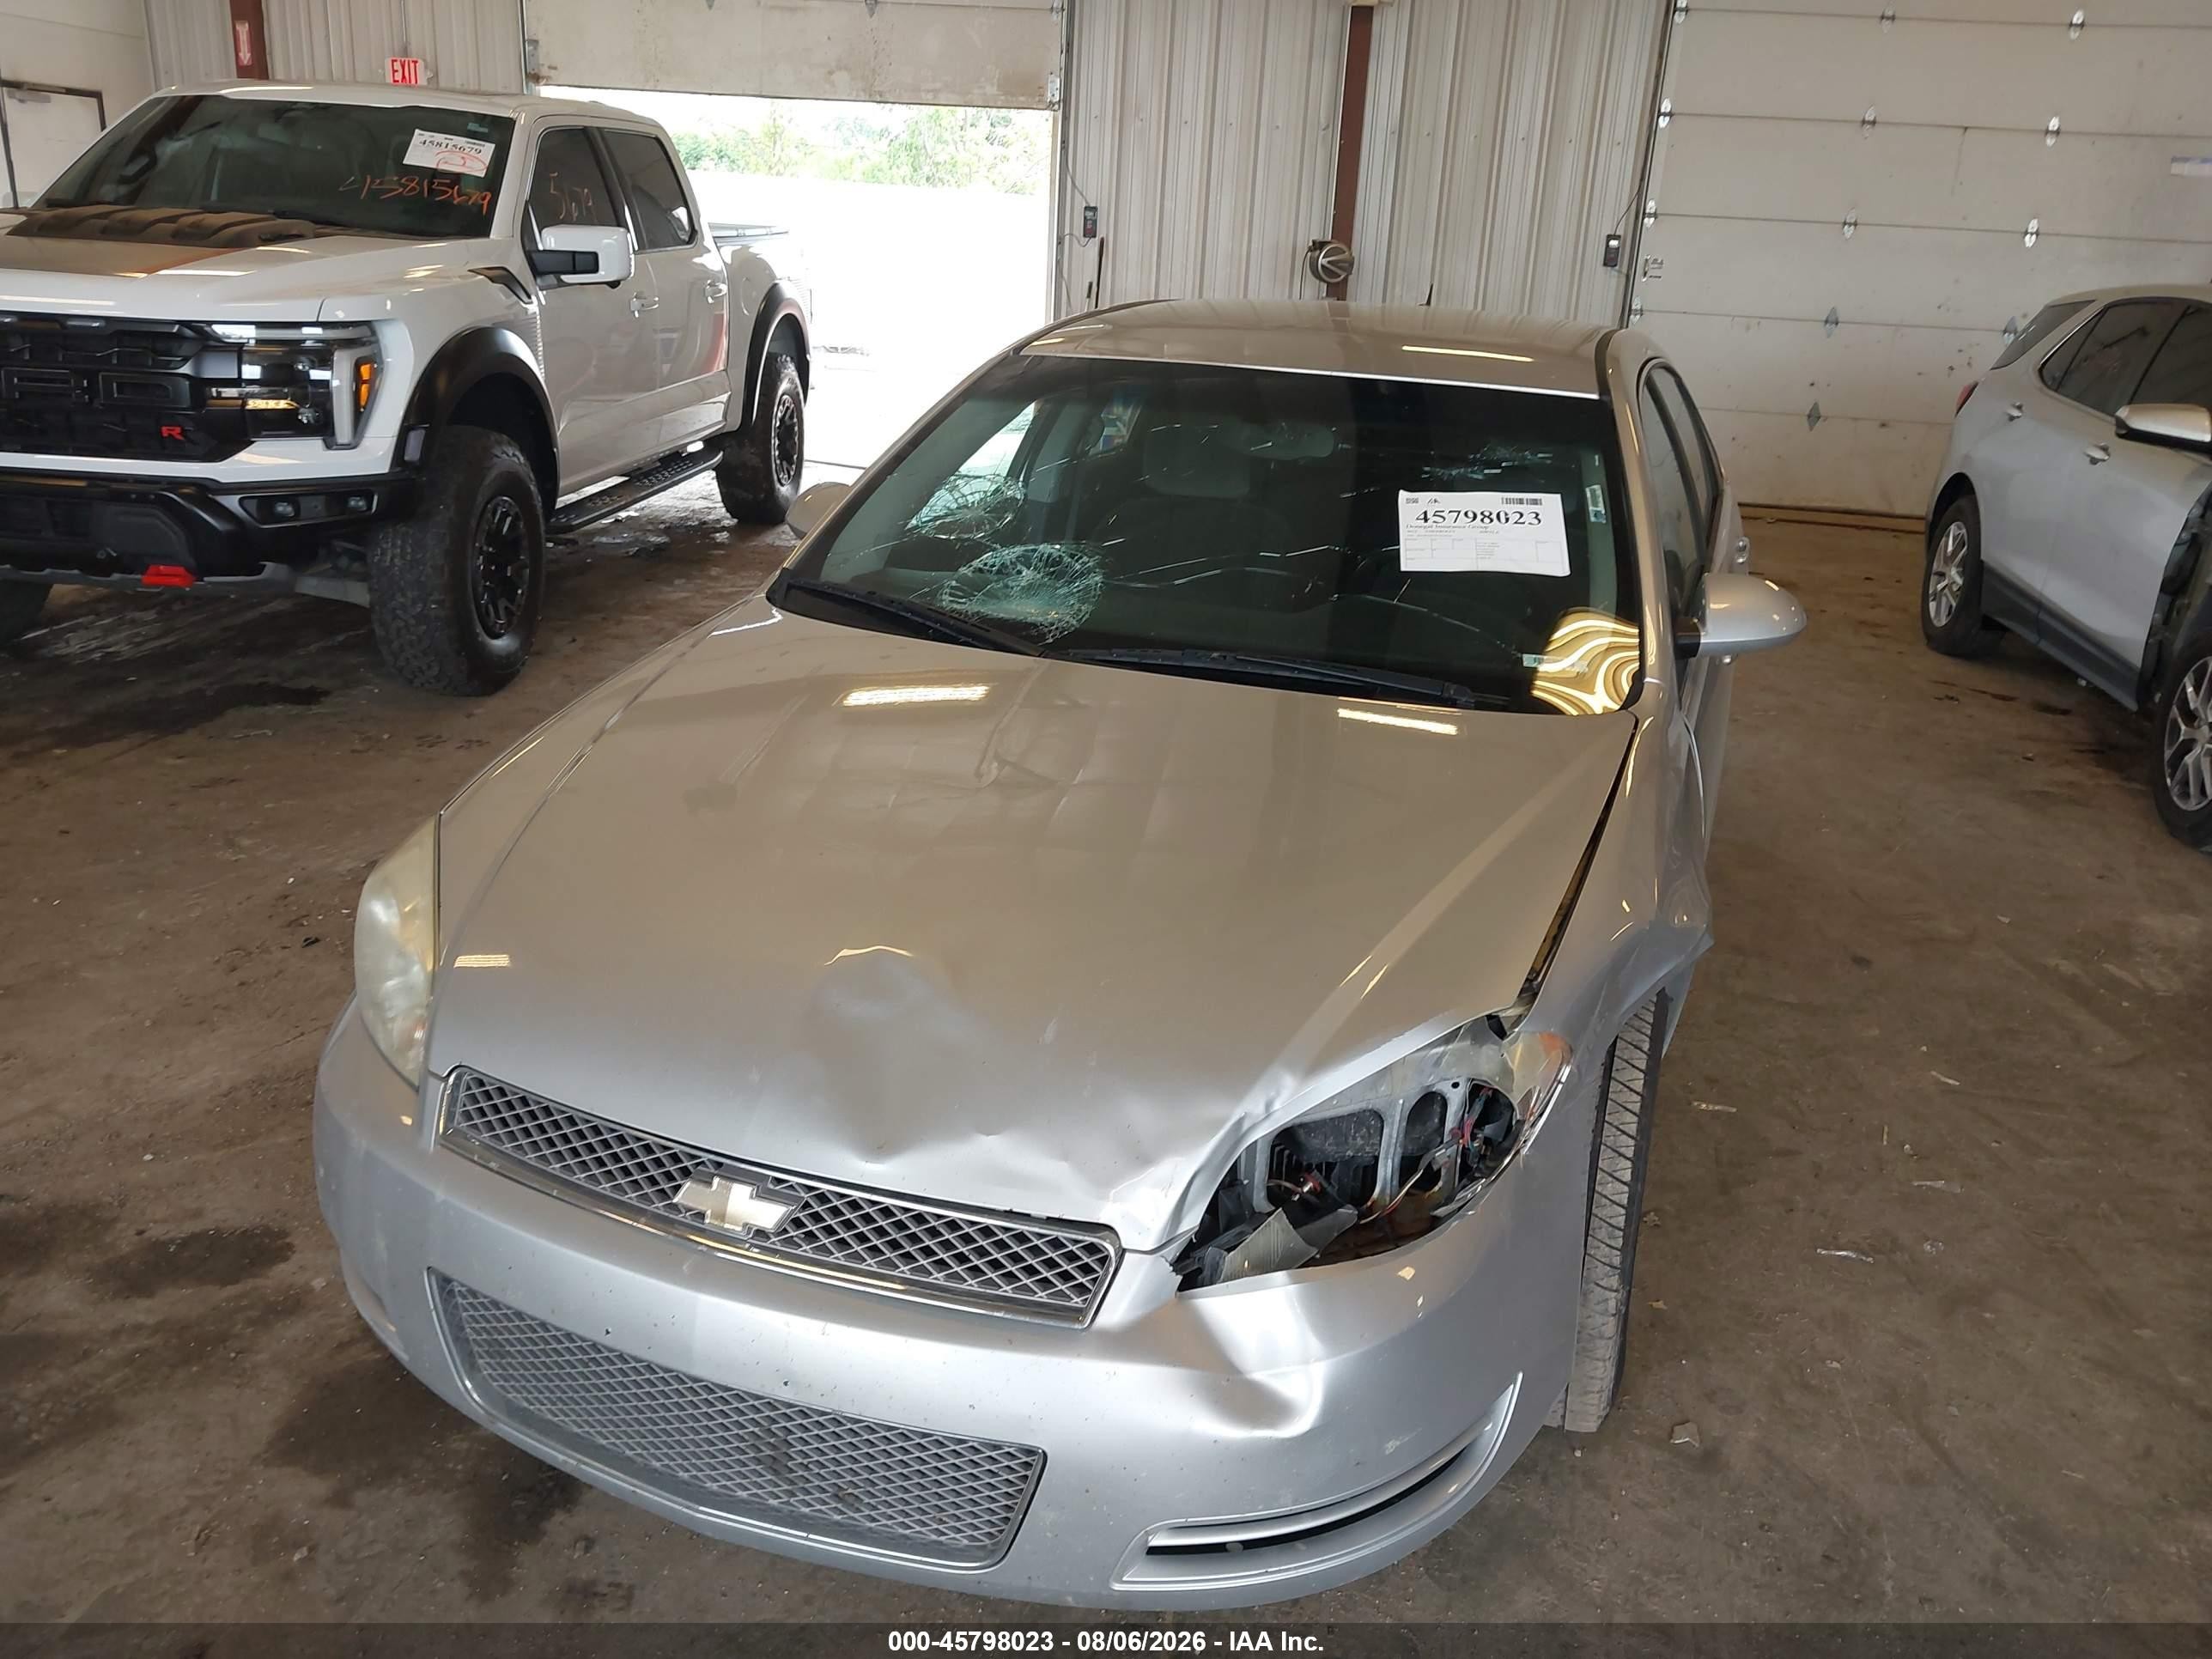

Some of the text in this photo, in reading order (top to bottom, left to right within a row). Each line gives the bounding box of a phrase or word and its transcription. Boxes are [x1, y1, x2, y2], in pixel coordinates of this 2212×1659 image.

[391, 58, 419, 85] EXIT
[418, 138, 483, 155] 45815679
[161, 425, 185, 441] R
[1414, 509, 1542, 526] 45798023
